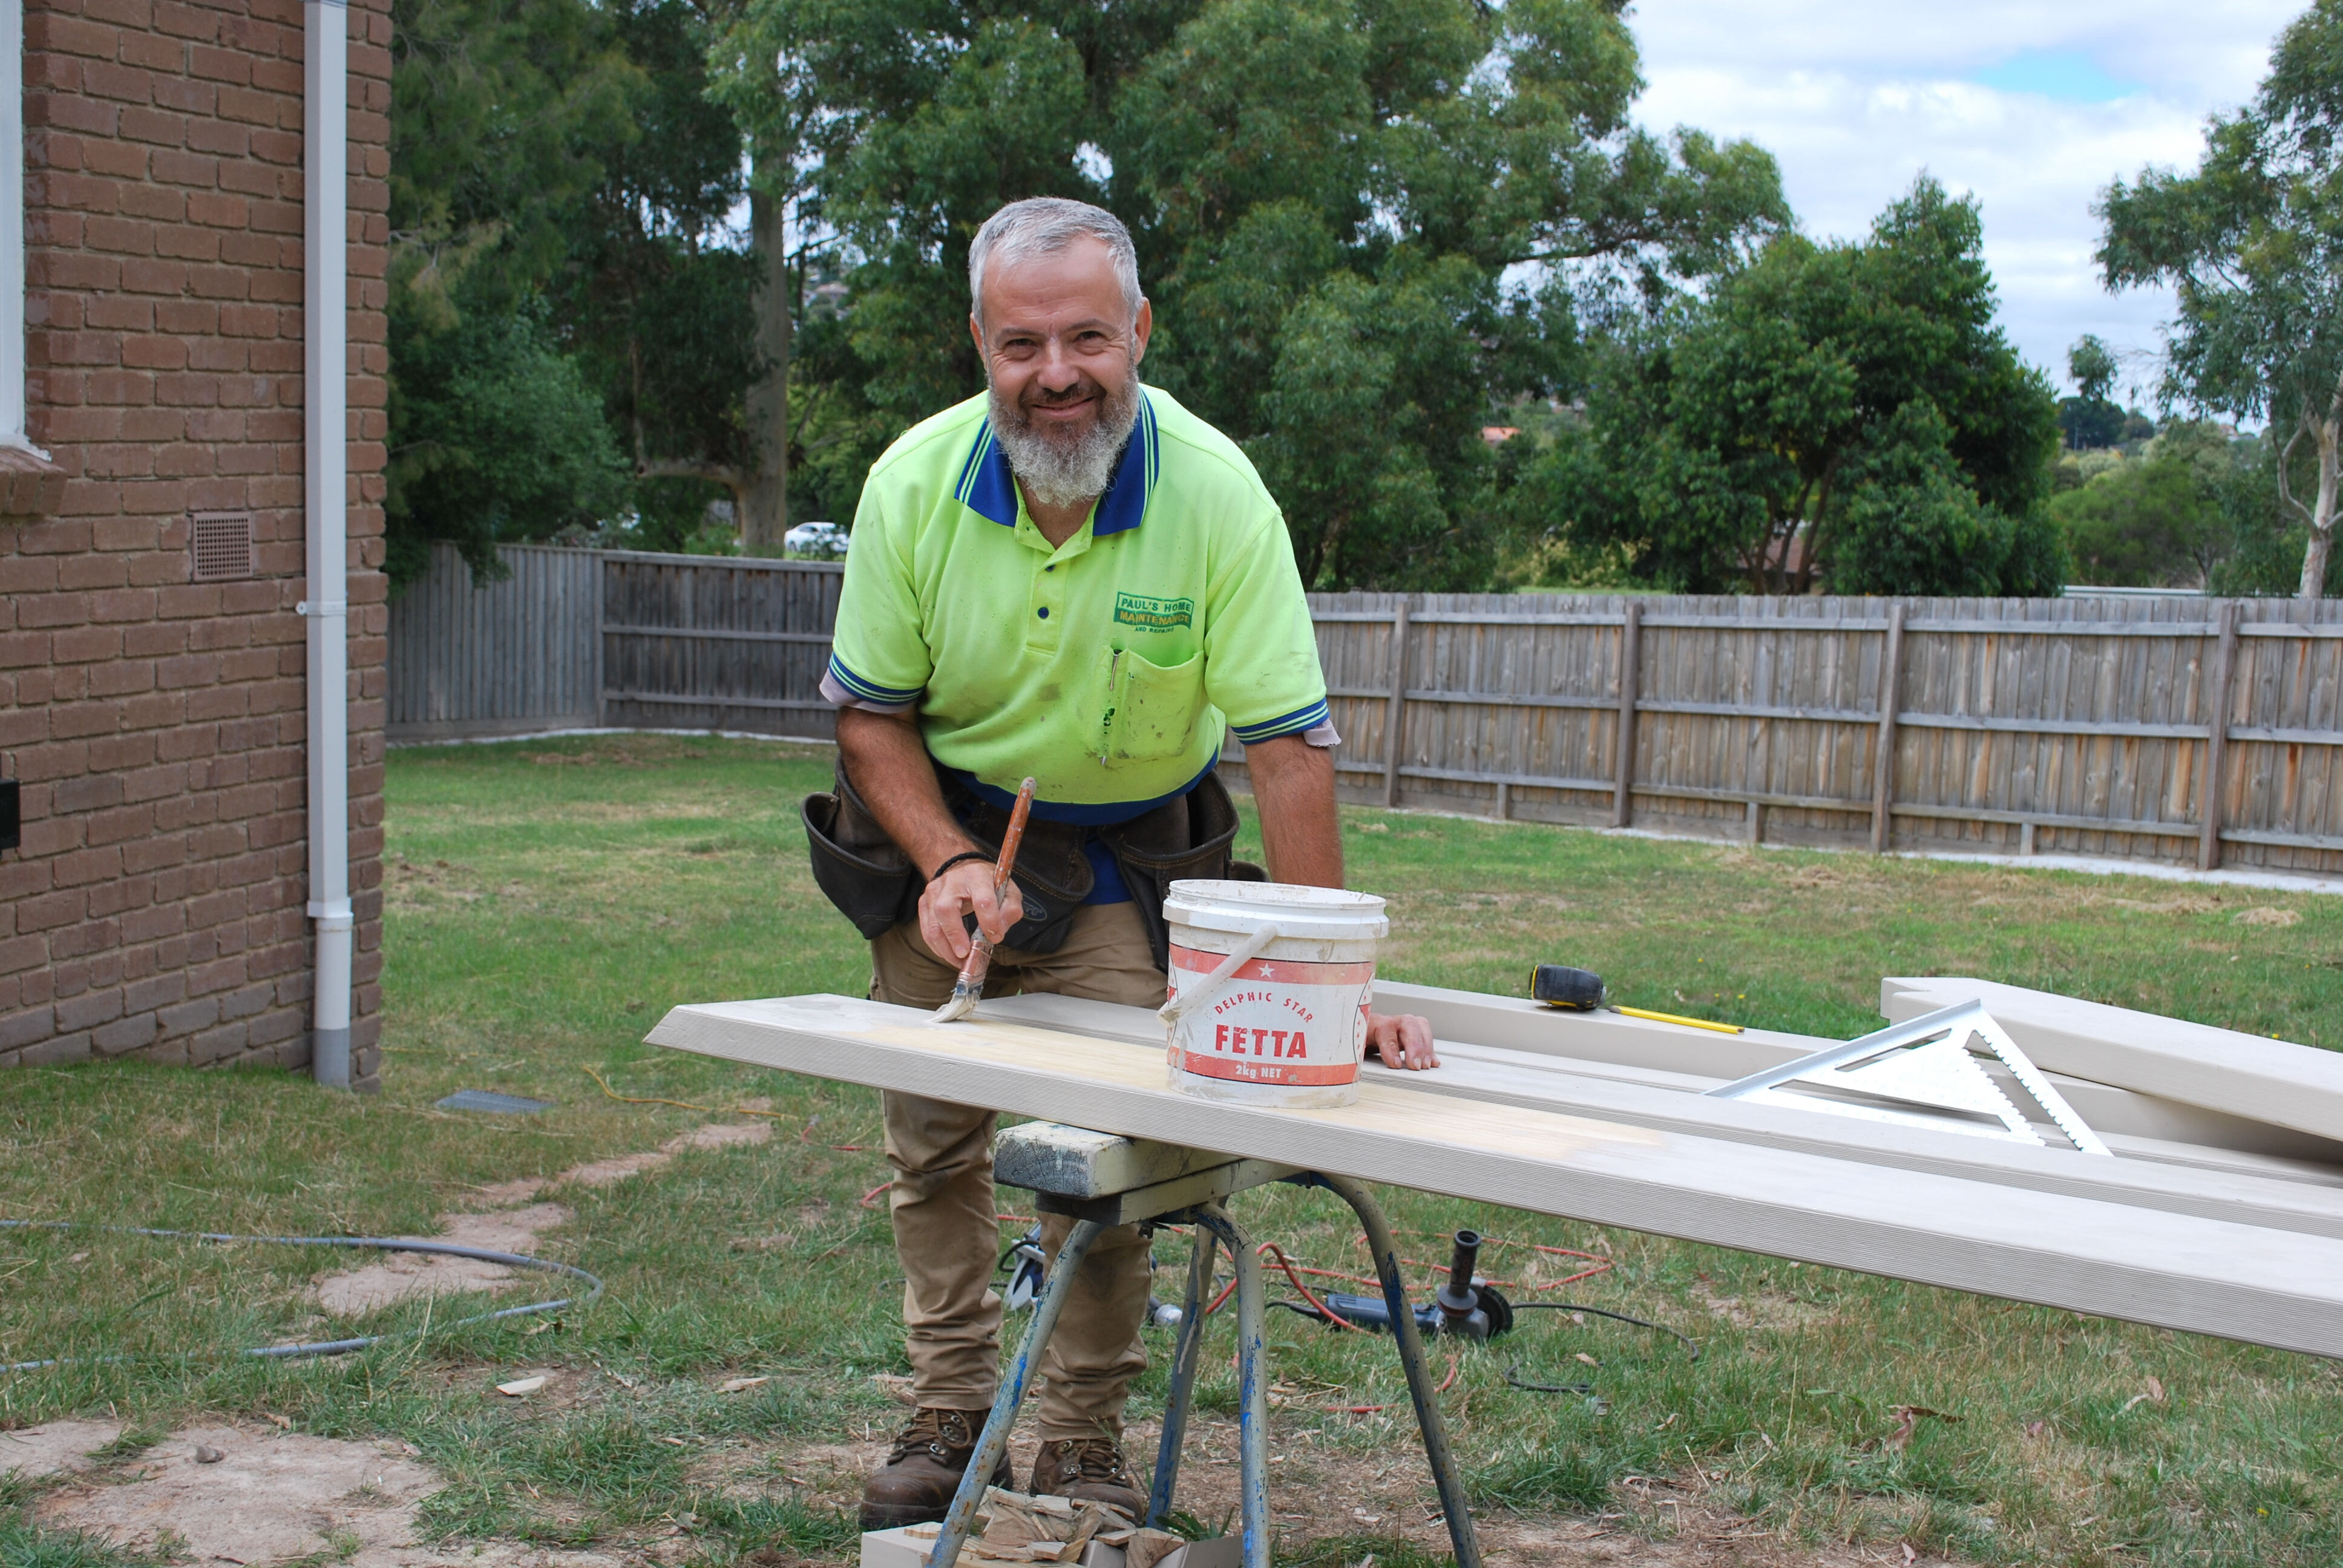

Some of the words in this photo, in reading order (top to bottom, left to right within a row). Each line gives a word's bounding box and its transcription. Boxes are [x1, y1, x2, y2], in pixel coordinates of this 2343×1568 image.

[1121, 598, 1158, 611] PAUL'S
[1164, 602, 1191, 613] HOME
[1120, 611, 1190, 624] MAINTENANCE
[1214, 992, 1271, 1014] DELPHIC
[1283, 998, 1312, 1022] STAR
[1215, 1024, 1306, 1058] FETTA
[1236, 1065, 1257, 1078] 2kg
[1261, 1067, 1282, 1078] NET
